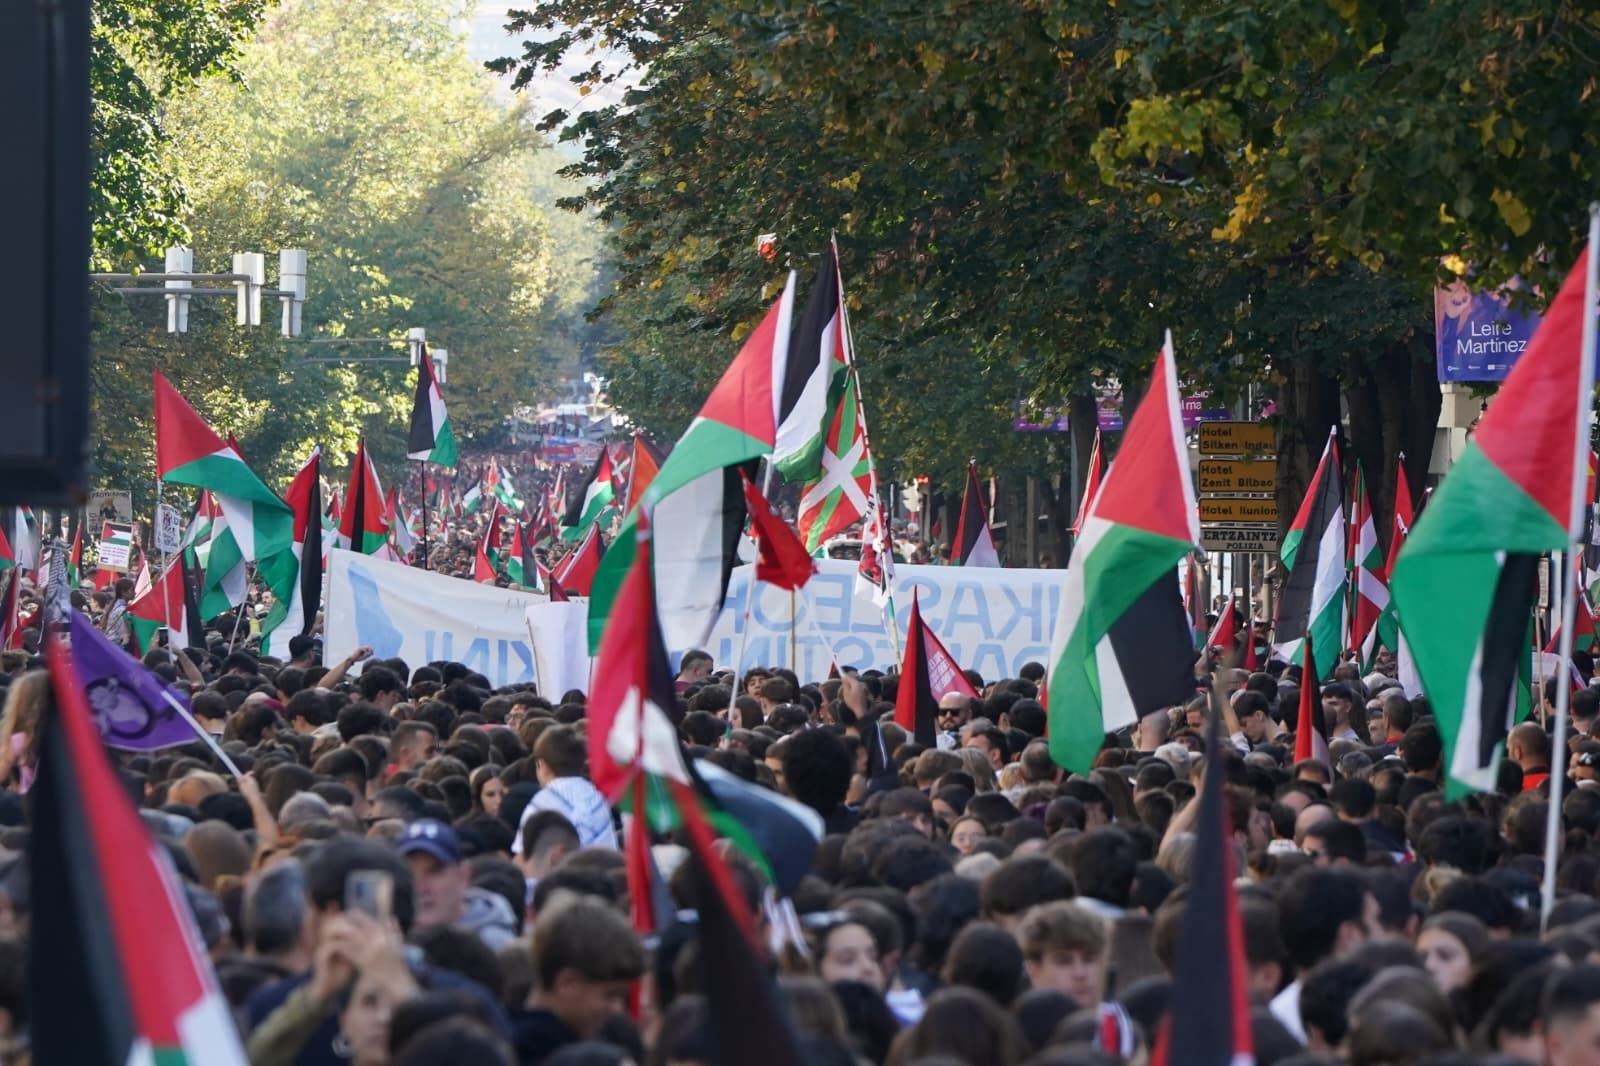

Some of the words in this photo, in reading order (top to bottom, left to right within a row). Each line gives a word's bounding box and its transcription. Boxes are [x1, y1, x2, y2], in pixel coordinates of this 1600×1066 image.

[1471, 320, 1512, 337] Leire
[1202, 427, 1232, 437] Hotel
[1202, 440, 1238, 450] Silken
[1201, 465, 1232, 474] Hotel
[1202, 478, 1231, 487] Zenit
[1238, 478, 1274, 487] Bilbao
[1202, 505, 1232, 514] Hotel
[1203, 531, 1277, 541] ERTZAINTZ
[1225, 542, 1265, 550] POLIZIA
